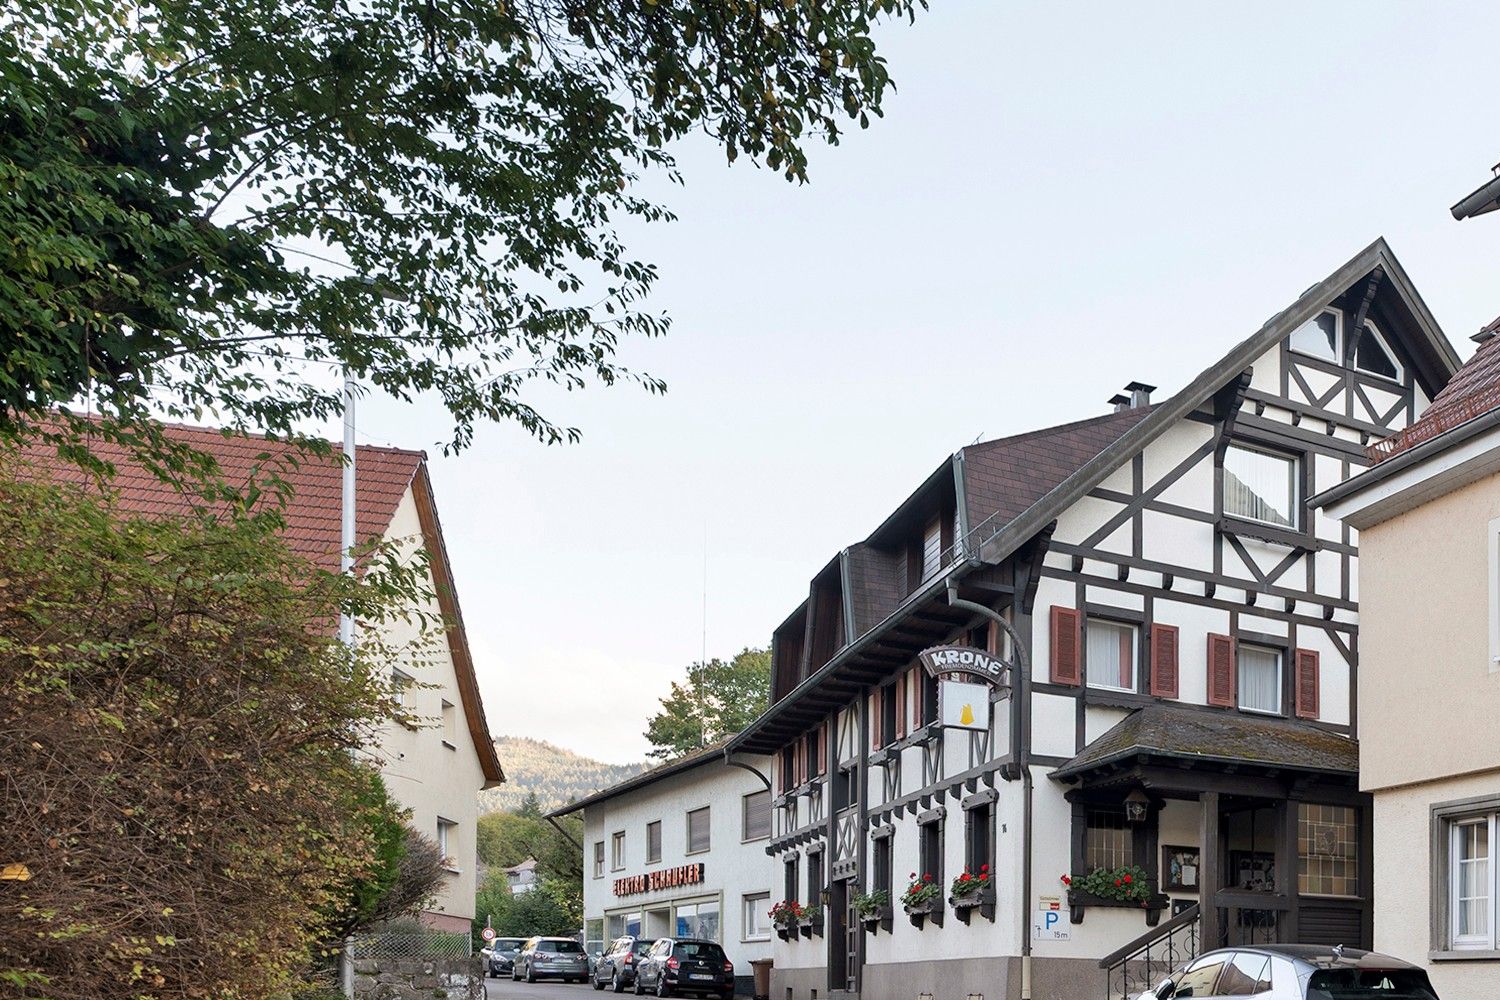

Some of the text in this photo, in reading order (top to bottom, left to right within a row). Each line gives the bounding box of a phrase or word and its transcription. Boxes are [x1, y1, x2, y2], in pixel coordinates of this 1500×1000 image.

[931, 650, 1003, 675] KRONE
[613, 875, 645, 896] ELEKTRO
[1046, 912, 1058, 929] P
